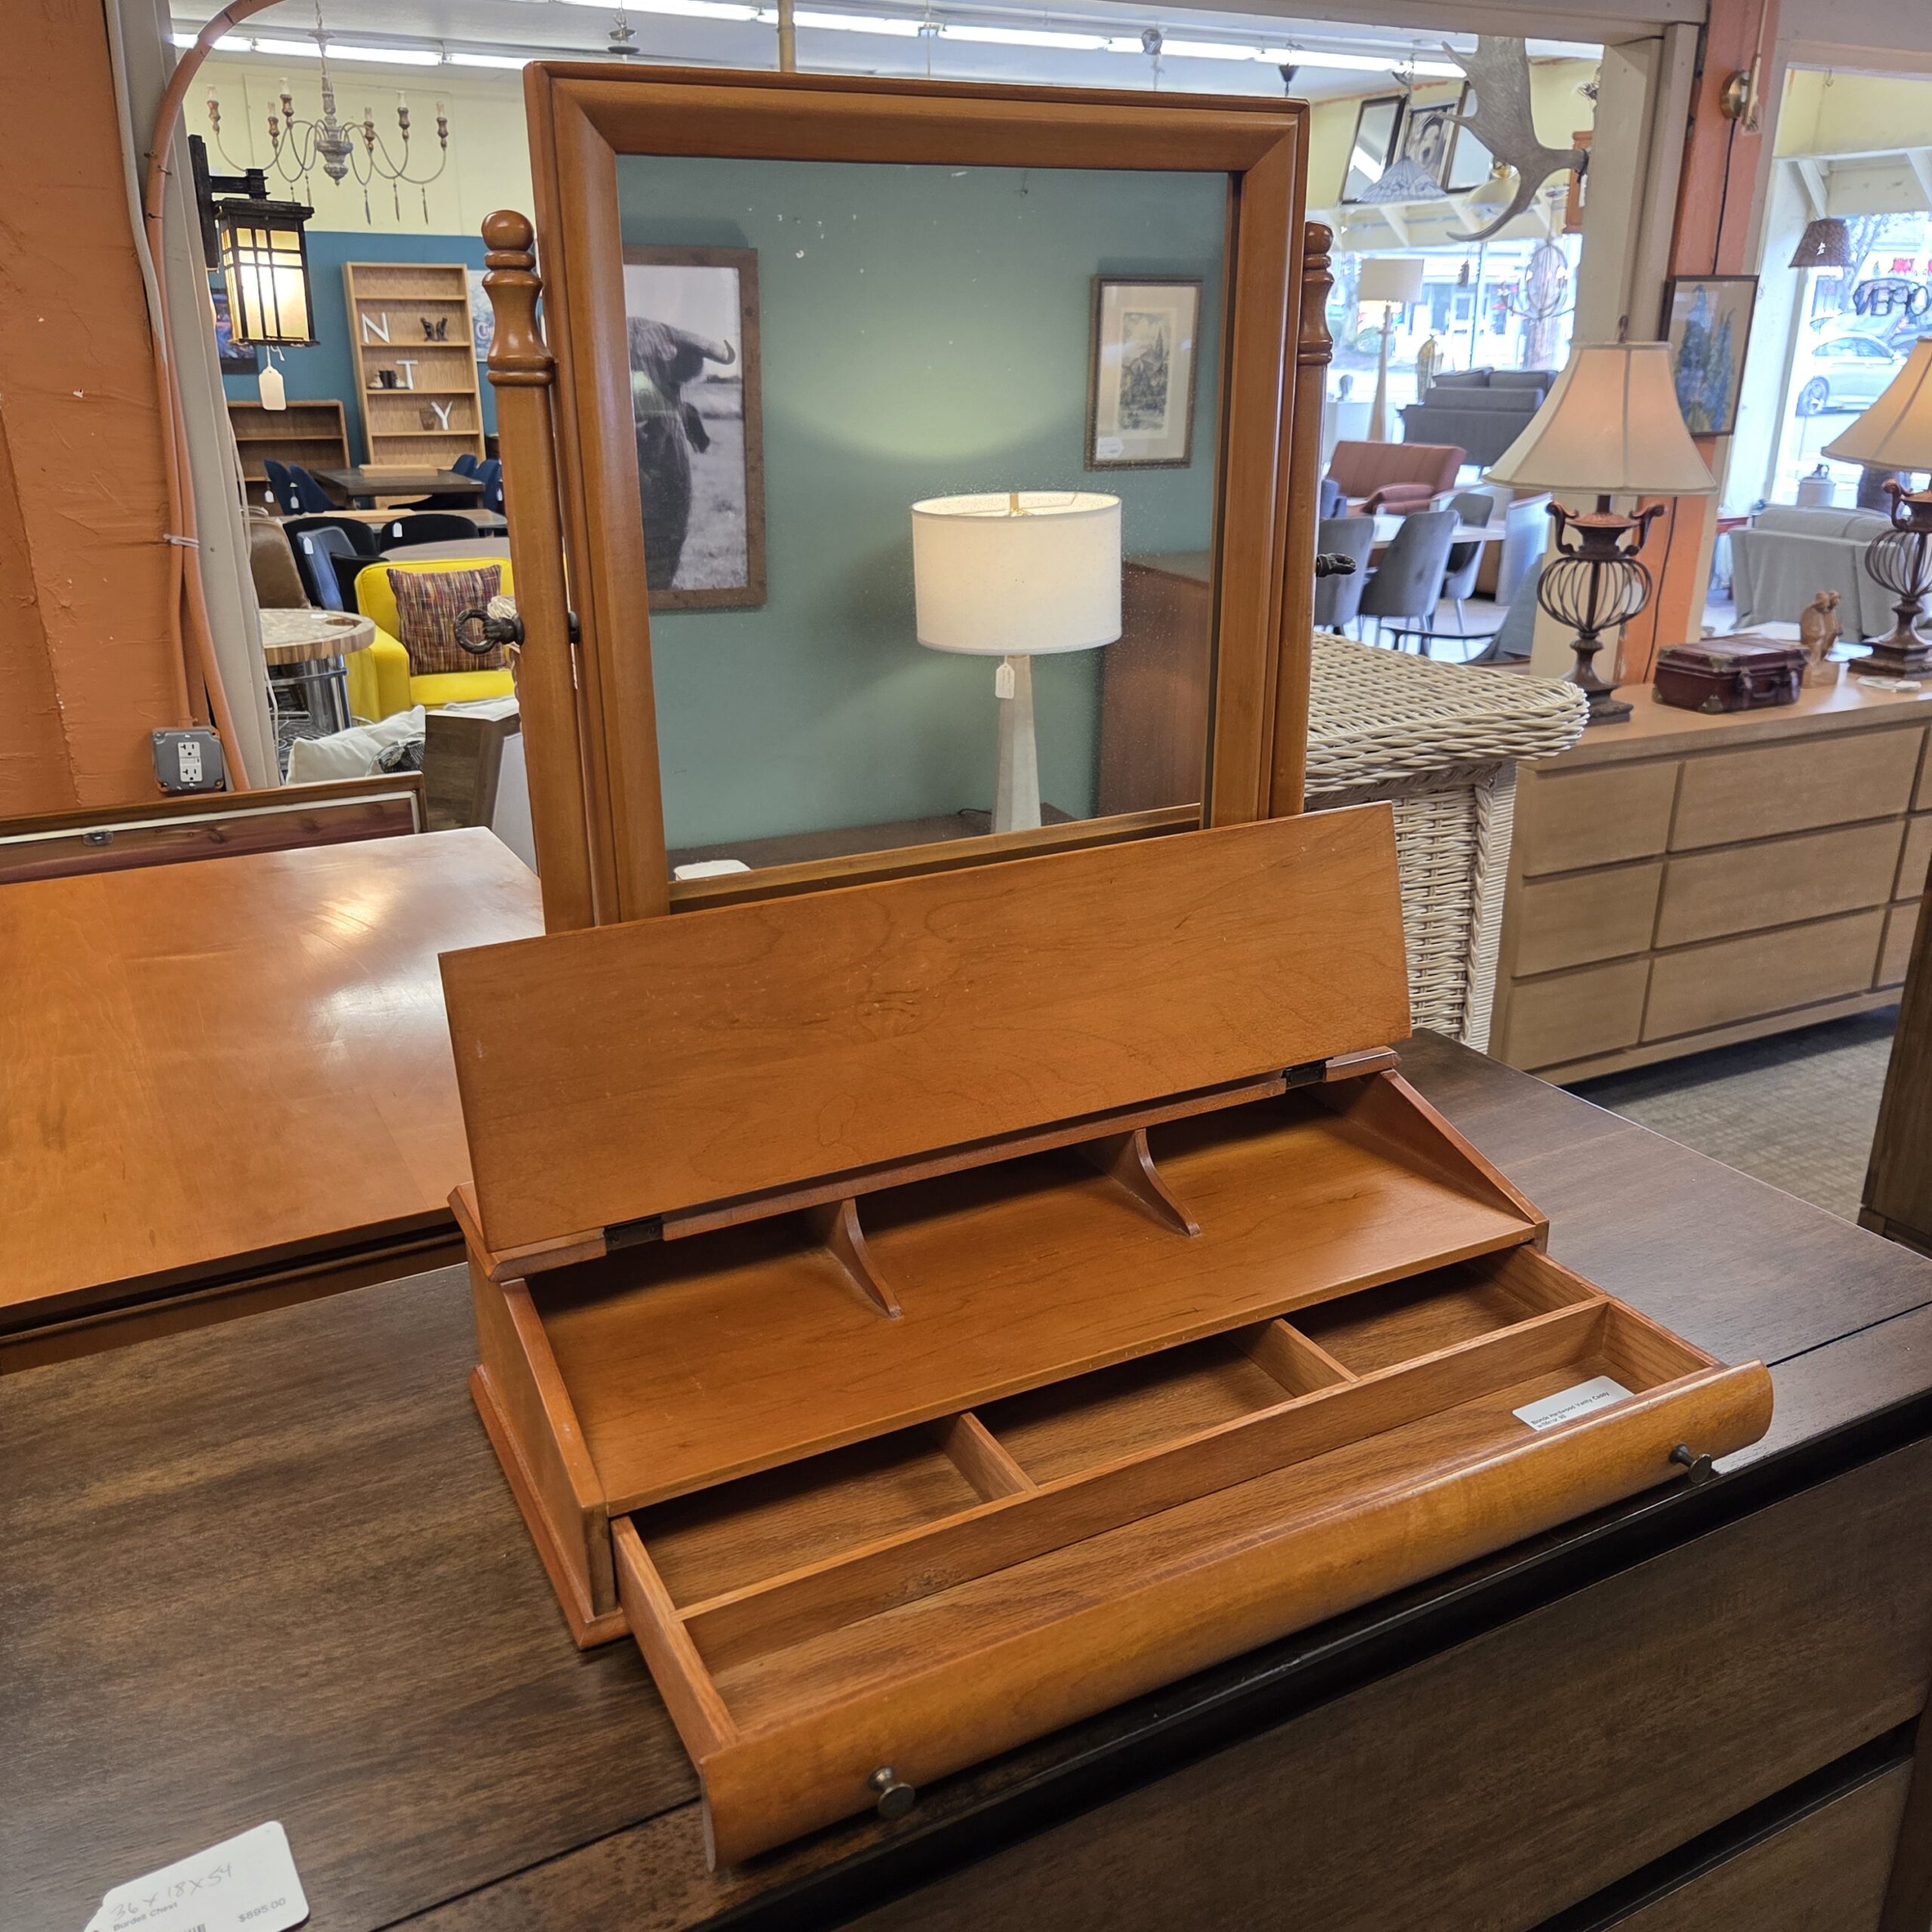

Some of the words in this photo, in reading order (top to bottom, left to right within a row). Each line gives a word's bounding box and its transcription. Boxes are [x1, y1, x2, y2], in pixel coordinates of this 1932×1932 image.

[361, 312, 390, 343] N
[395, 359, 419, 390] T
[430, 400, 453, 430] Y
[1592, 1391, 1611, 1401] Caddy
[149, 1902, 178, 1917] Chest
[238, 1897, 287, 1924] $895.00
